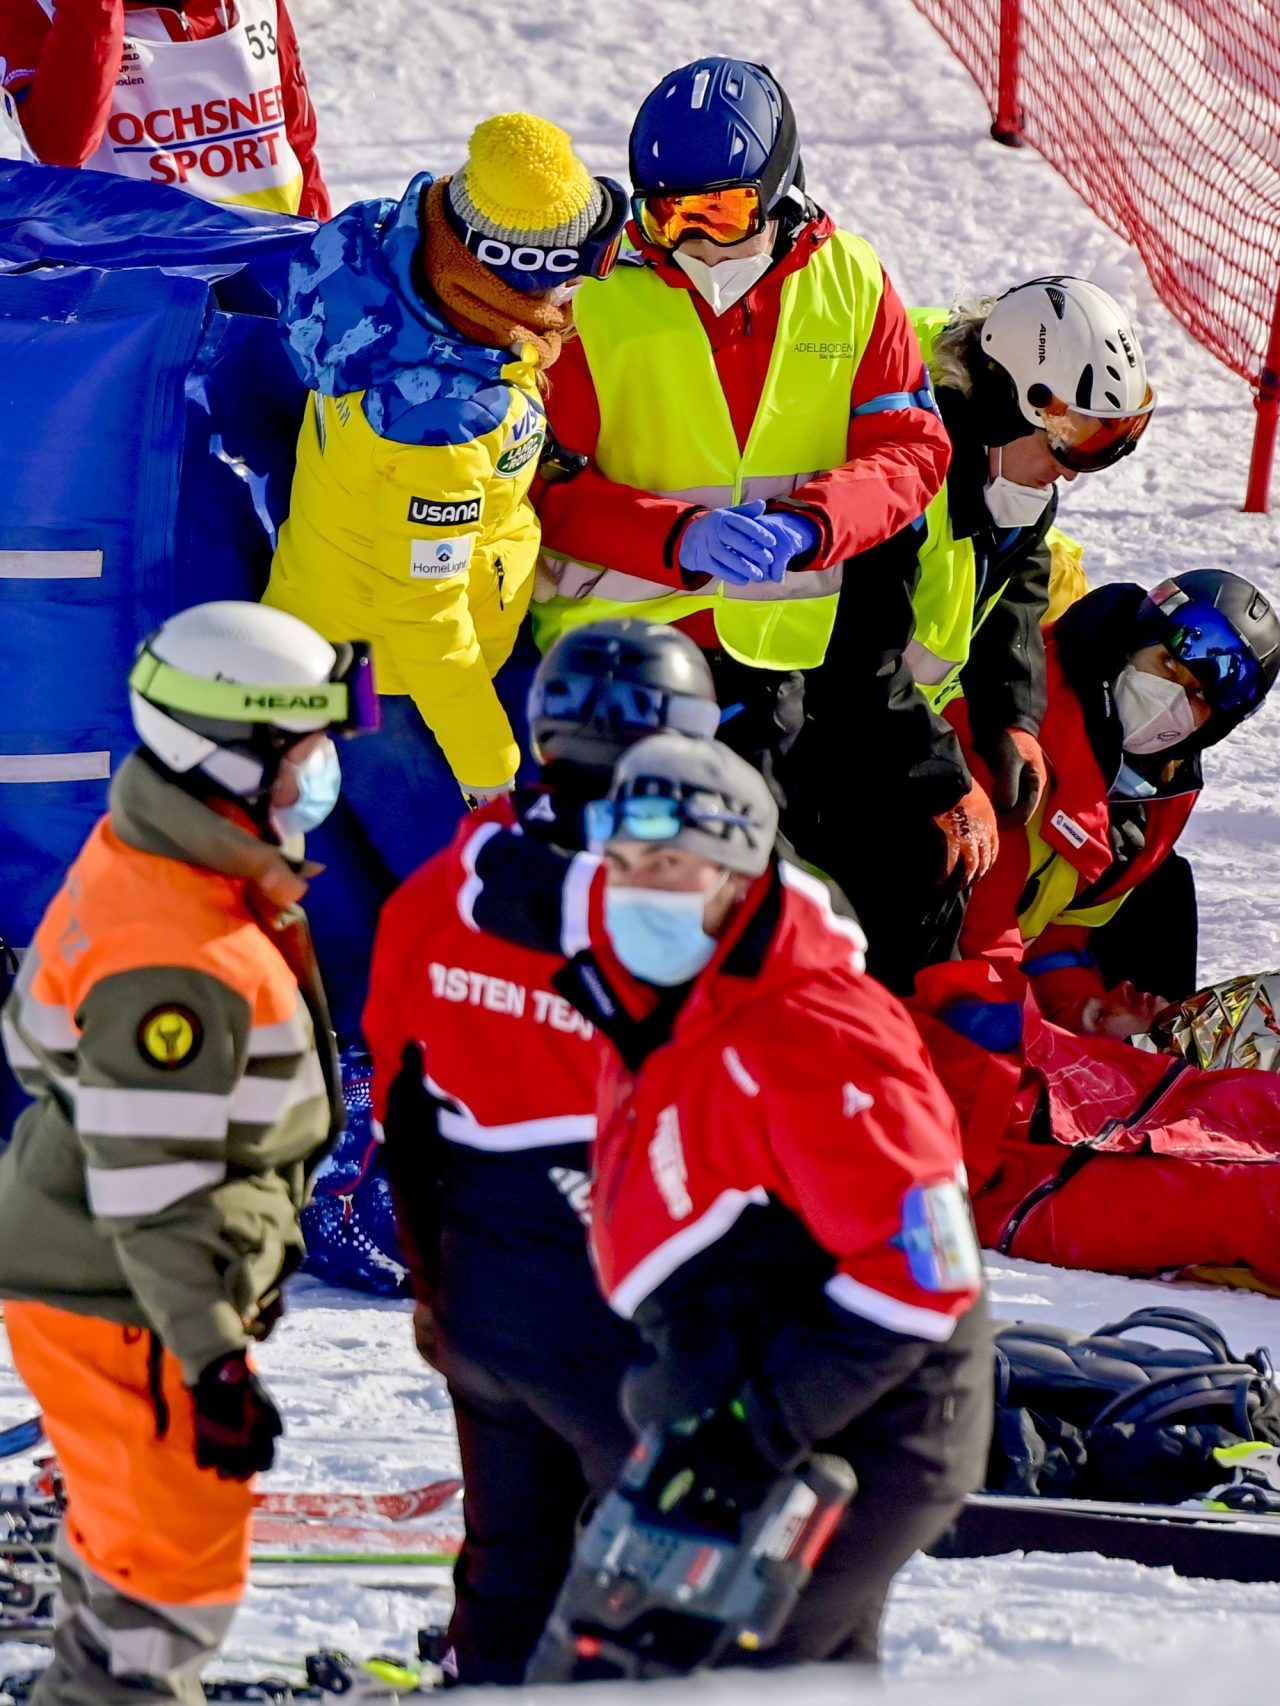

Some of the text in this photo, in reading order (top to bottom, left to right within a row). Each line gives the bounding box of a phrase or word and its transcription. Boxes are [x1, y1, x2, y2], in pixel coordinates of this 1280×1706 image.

[245, 20, 277, 60] 53
[150, 132, 280, 186] SPORT
[411, 501, 480, 523] USANA
[412, 558, 468, 574] HomeLight
[244, 694, 329, 710] HEAD
